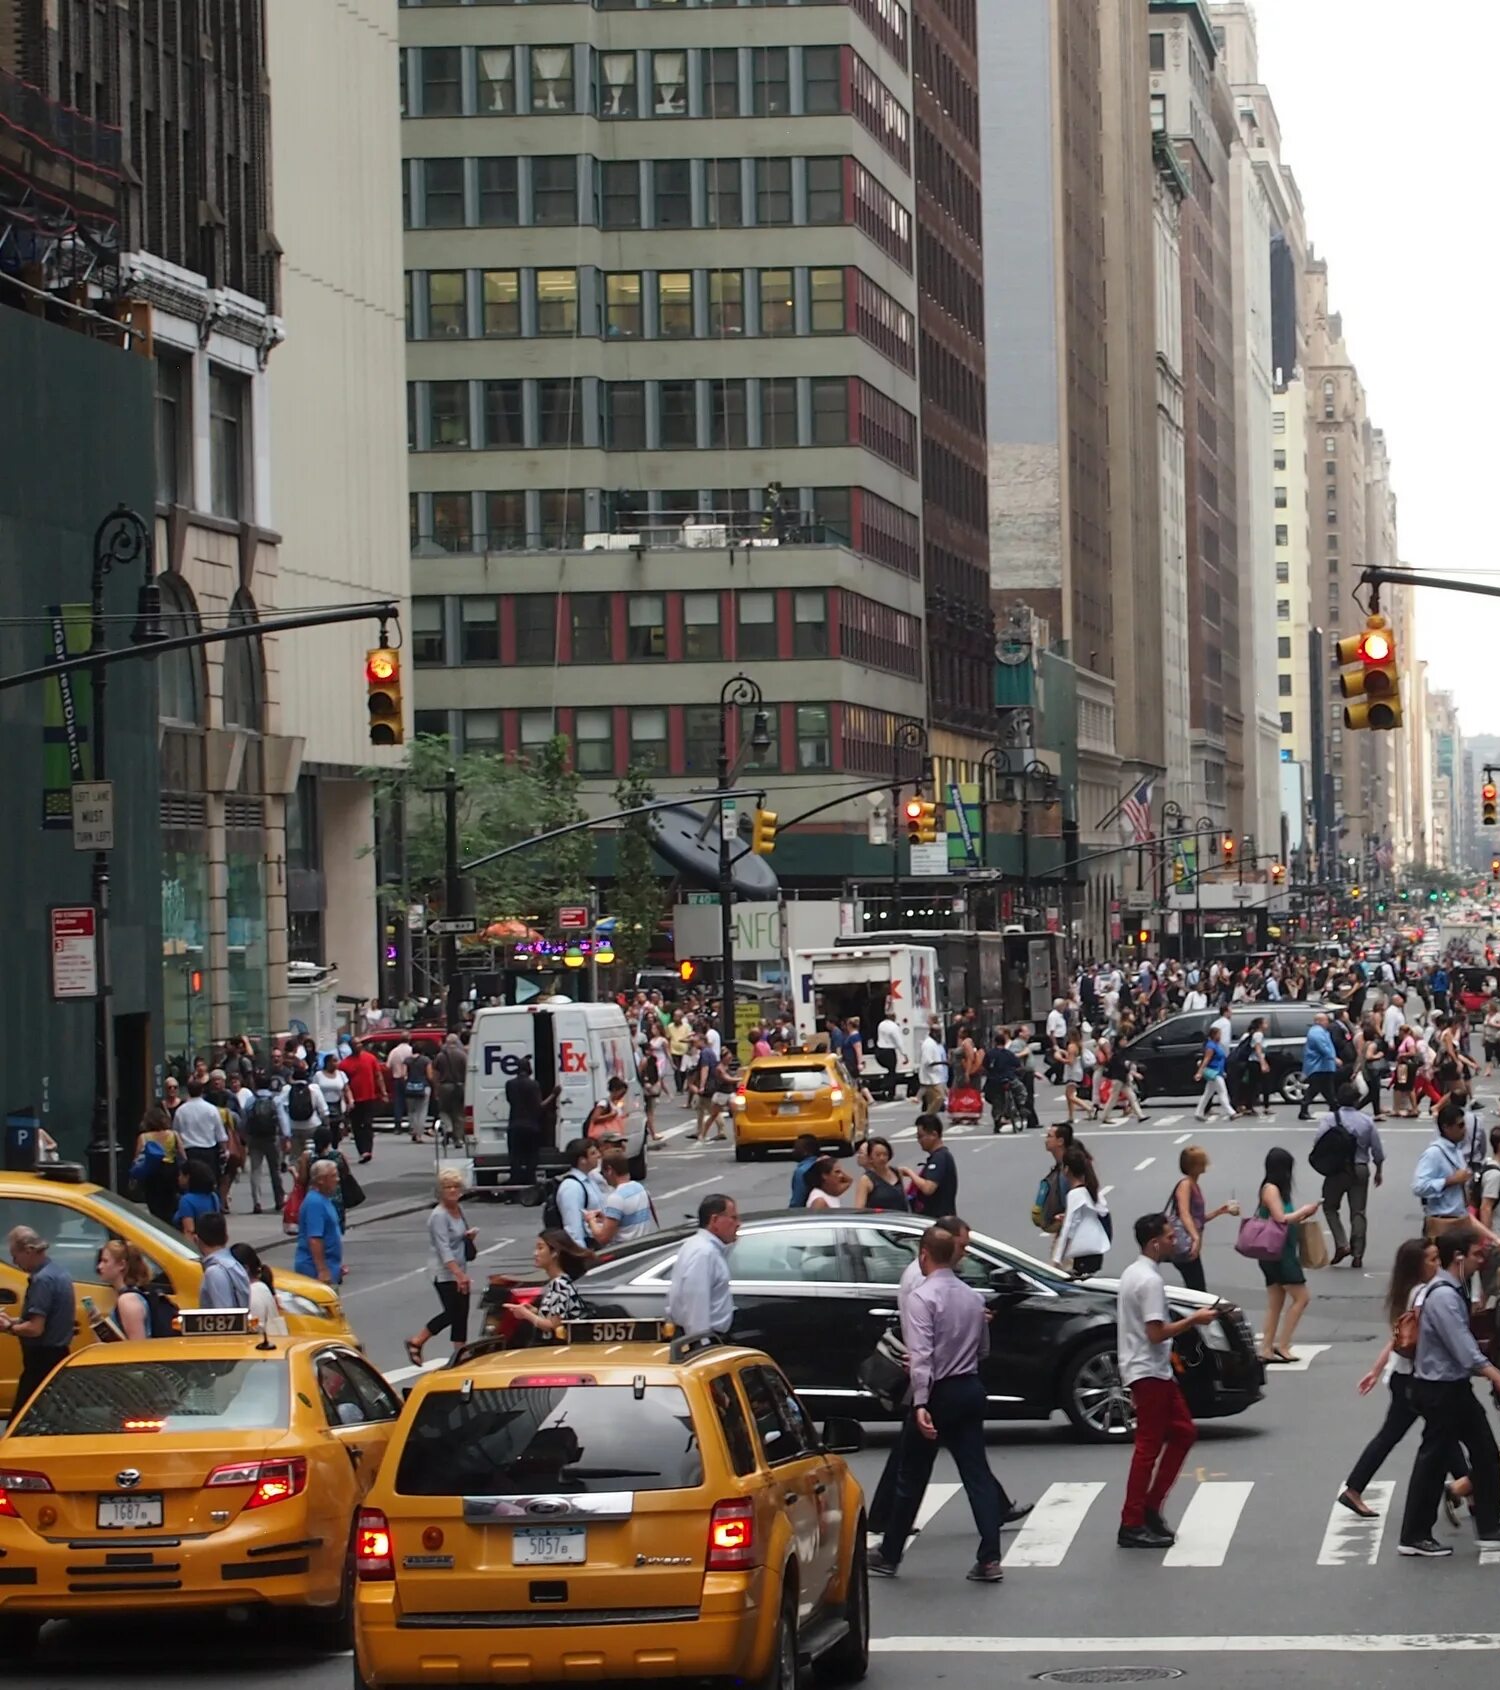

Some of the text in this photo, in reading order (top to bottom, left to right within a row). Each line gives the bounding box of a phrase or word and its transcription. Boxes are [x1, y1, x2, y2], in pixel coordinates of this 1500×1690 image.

[18, 1130, 28, 1146] P
[196, 1316, 236, 1331] 1G87
[592, 1323, 636, 1341] 5D57
